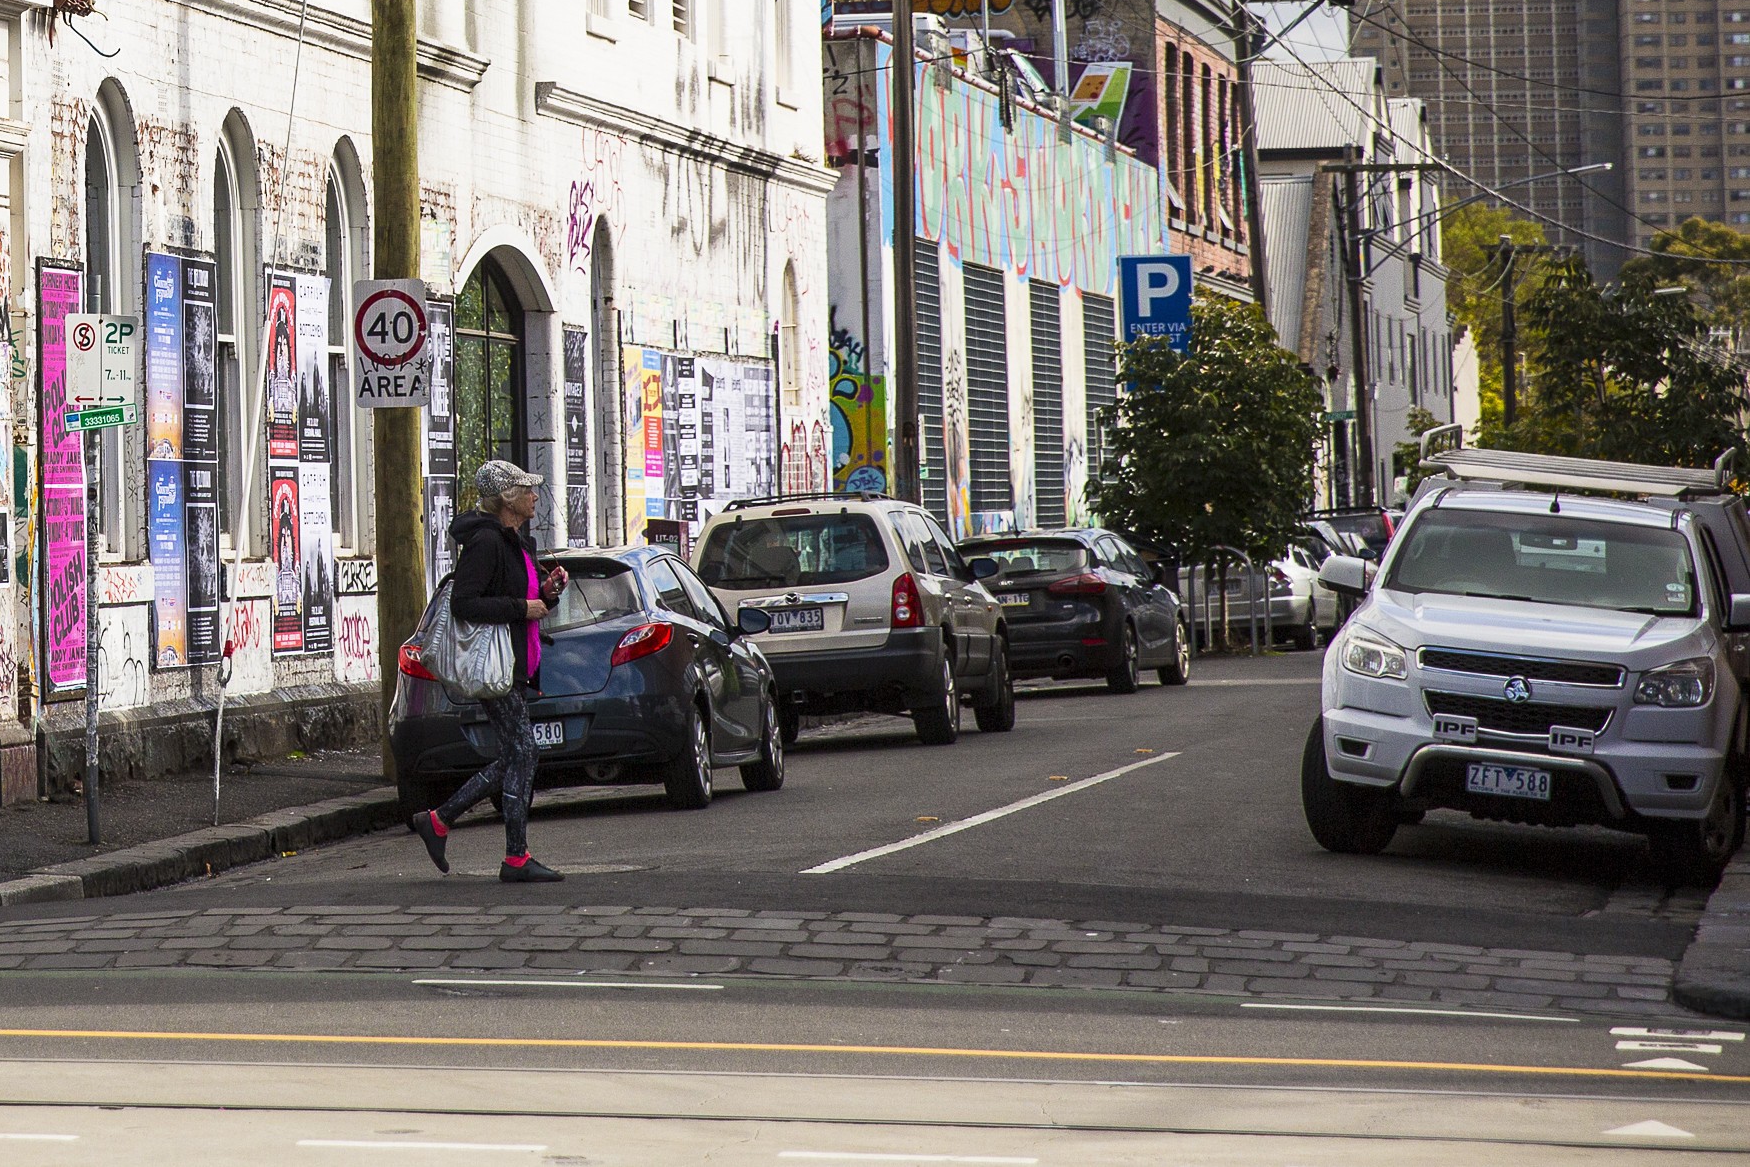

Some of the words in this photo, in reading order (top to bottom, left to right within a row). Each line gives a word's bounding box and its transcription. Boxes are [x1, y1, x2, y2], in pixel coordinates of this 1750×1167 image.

[105, 322, 134, 344] 2P
[367, 311, 413, 344] 40
[1130, 323, 1165, 333] ENTER
[1167, 322, 1186, 332] VIA
[107, 346, 130, 355] TICKET
[359, 375, 426, 398] AREA
[84, 414, 120, 426] 33331065
[66, 451, 81, 464] JANE
[655, 534, 679, 543] LIT-02
[54, 592, 79, 647] CLUB
[799, 610, 820, 623] 835
[50, 648, 66, 662] ADDY
[68, 646, 85, 661] JANE
[536, 724, 561, 740] 580
[1435, 720, 1475, 734] IPF
[1551, 733, 1592, 747] IPF
[1470, 767, 1501, 787] ZFT
[1516, 773, 1548, 792] 588
